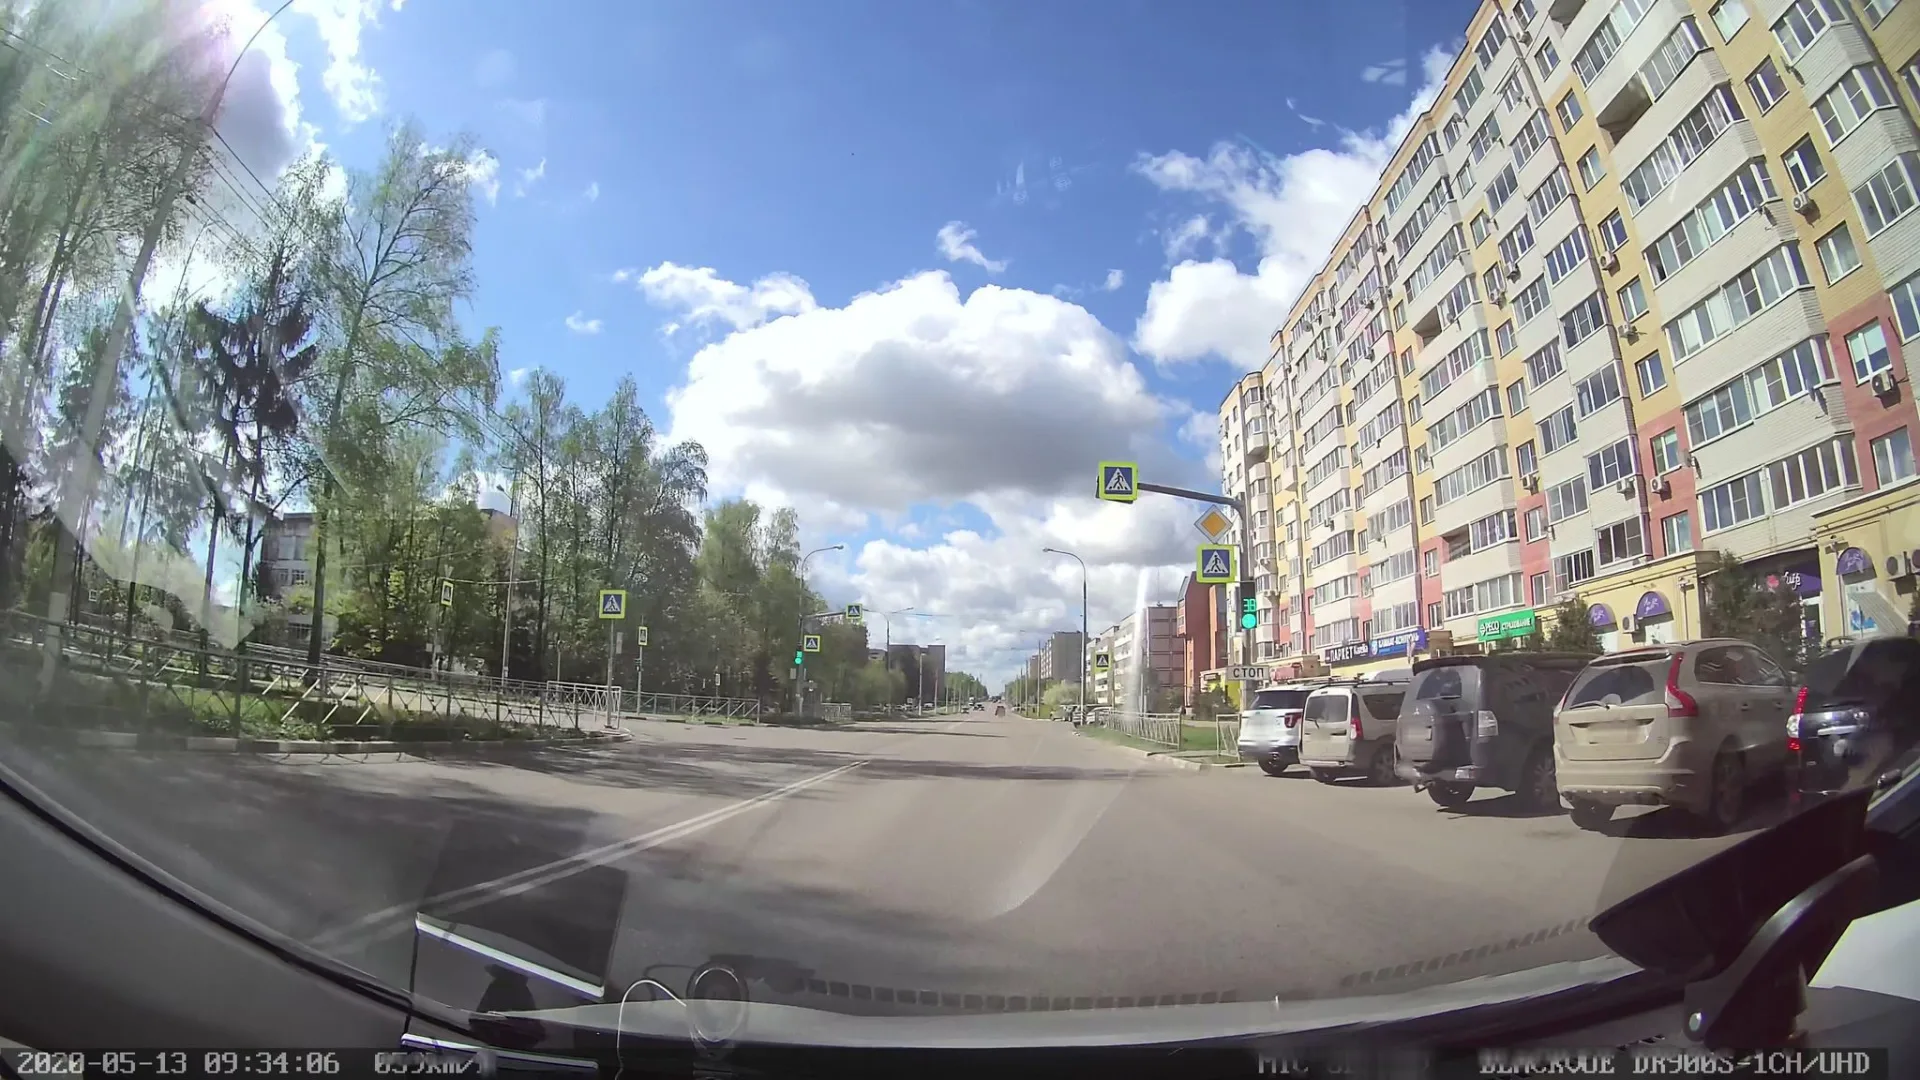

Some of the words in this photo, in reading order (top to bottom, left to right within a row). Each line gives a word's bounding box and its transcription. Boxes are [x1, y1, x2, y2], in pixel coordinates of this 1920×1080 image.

[1485, 620, 1500, 633] РЕСО
[1330, 646, 1353, 662] ПАРКЕТ
[1233, 667, 1264, 678] СТОП
